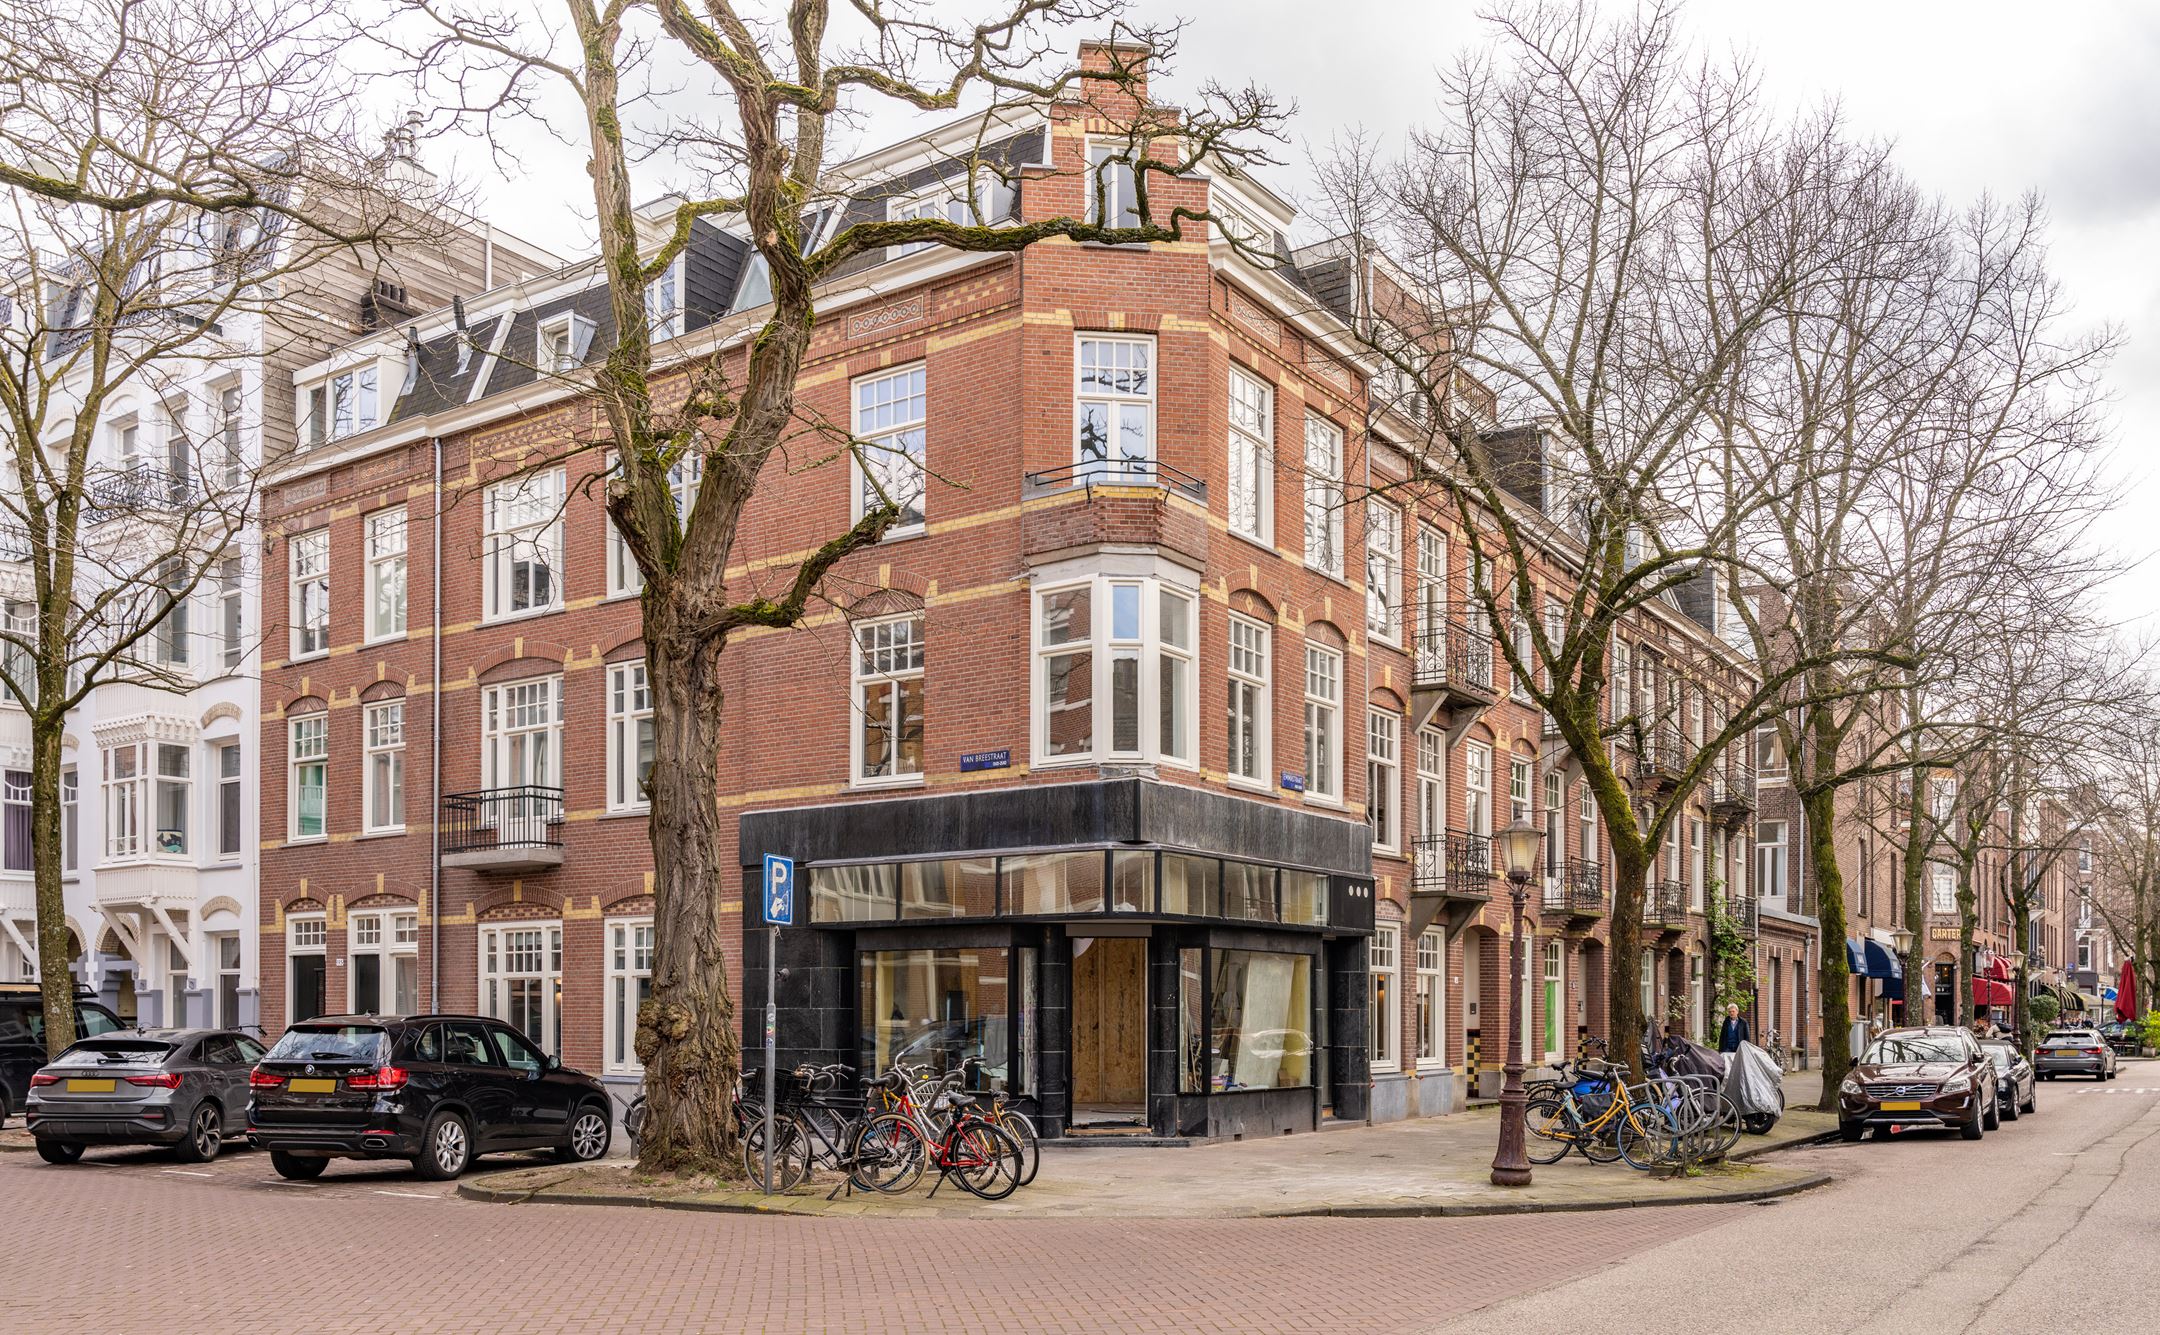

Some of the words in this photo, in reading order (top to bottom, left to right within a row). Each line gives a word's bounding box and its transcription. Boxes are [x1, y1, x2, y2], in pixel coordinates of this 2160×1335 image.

[975, 752, 1006, 762] BREESTRAAT
[772, 861, 787, 894] P
[1932, 928, 1961, 939] CARTER
